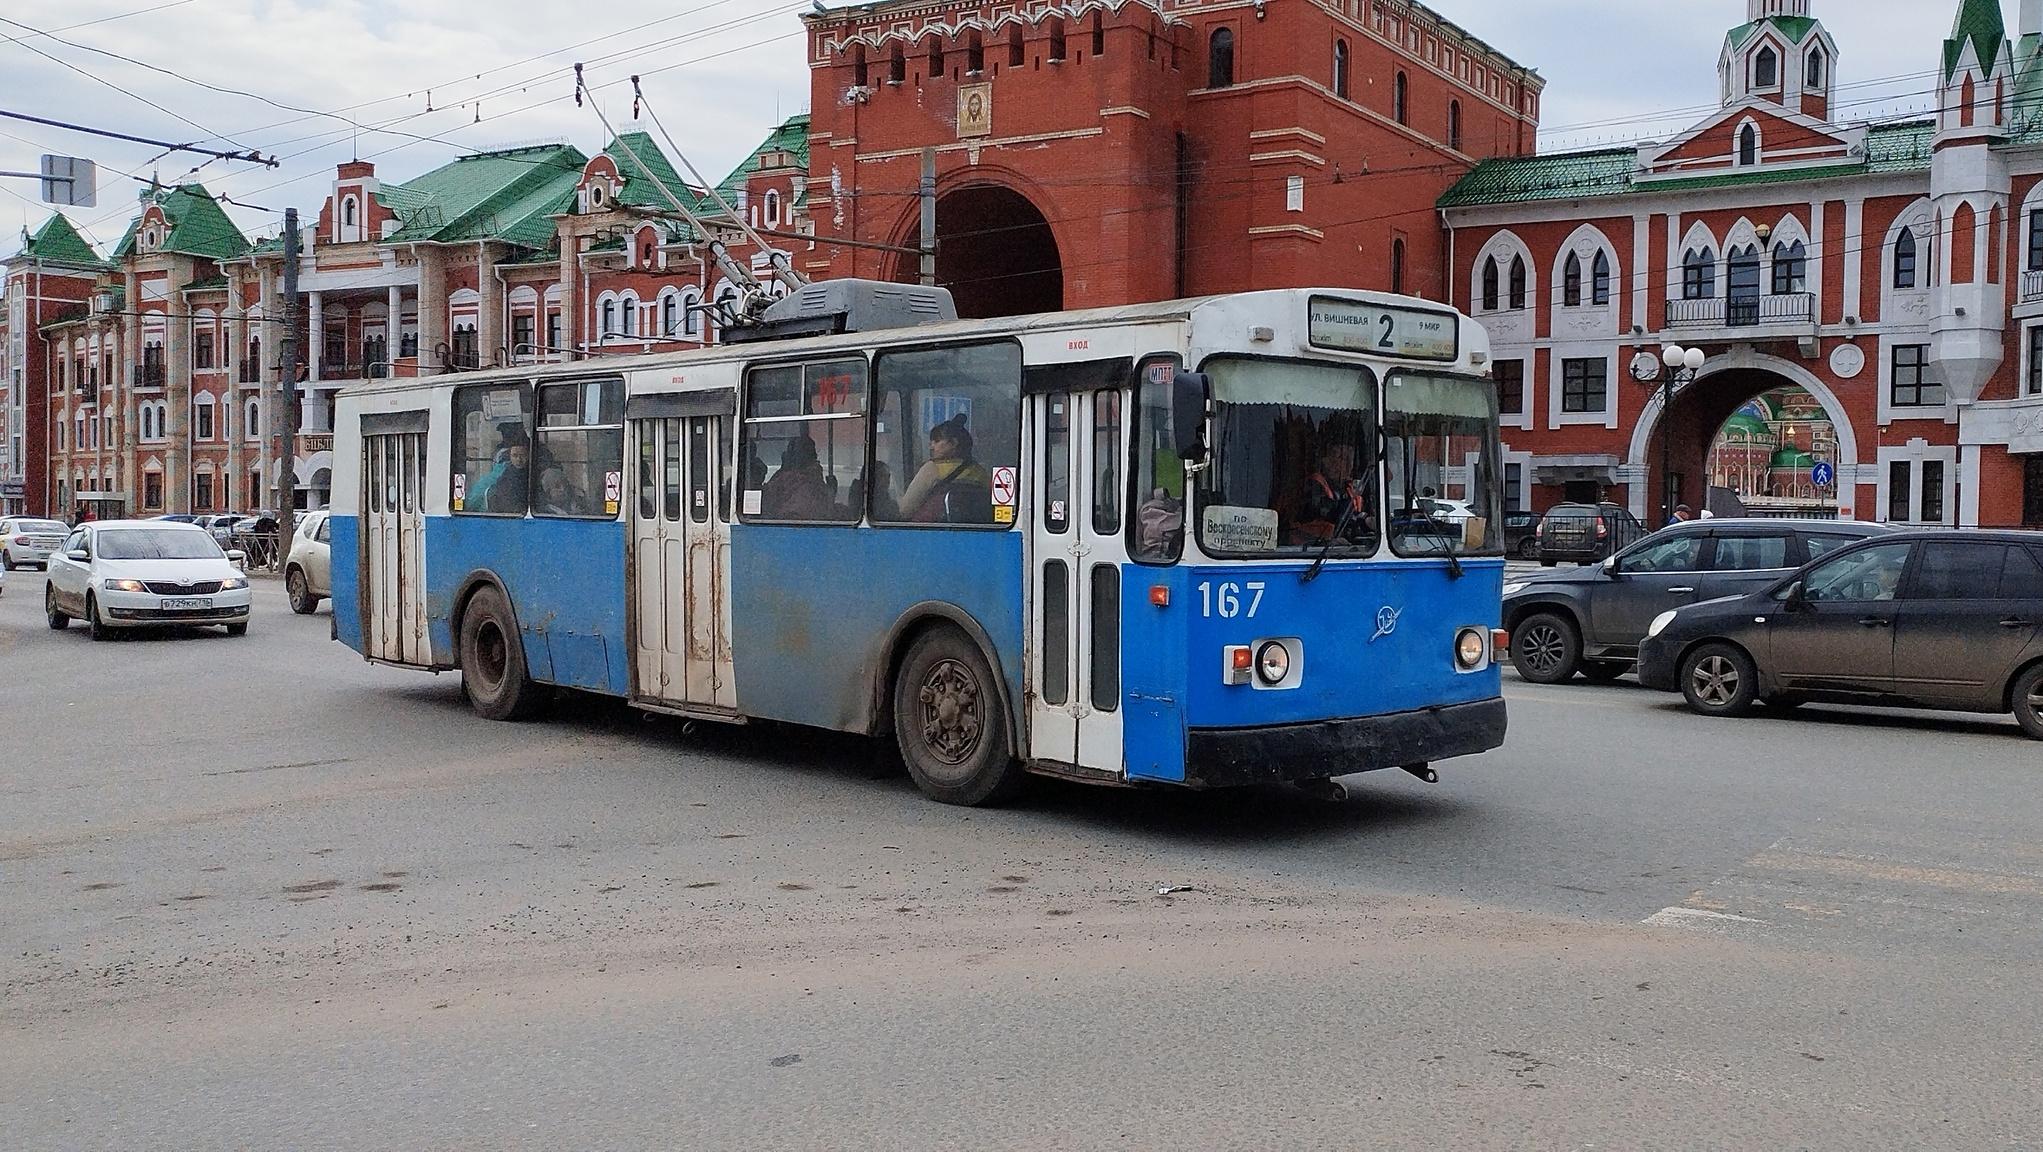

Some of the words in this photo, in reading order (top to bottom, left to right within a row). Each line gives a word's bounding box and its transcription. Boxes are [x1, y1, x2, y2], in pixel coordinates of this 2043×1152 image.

[1324, 313, 1369, 326] ВИШНЕВАЯ
[1419, 321, 1424, 330] 9
[1378, 314, 1395, 348] 2
[1068, 340, 1089, 350] ВХОД
[1198, 582, 1265, 618] 167
